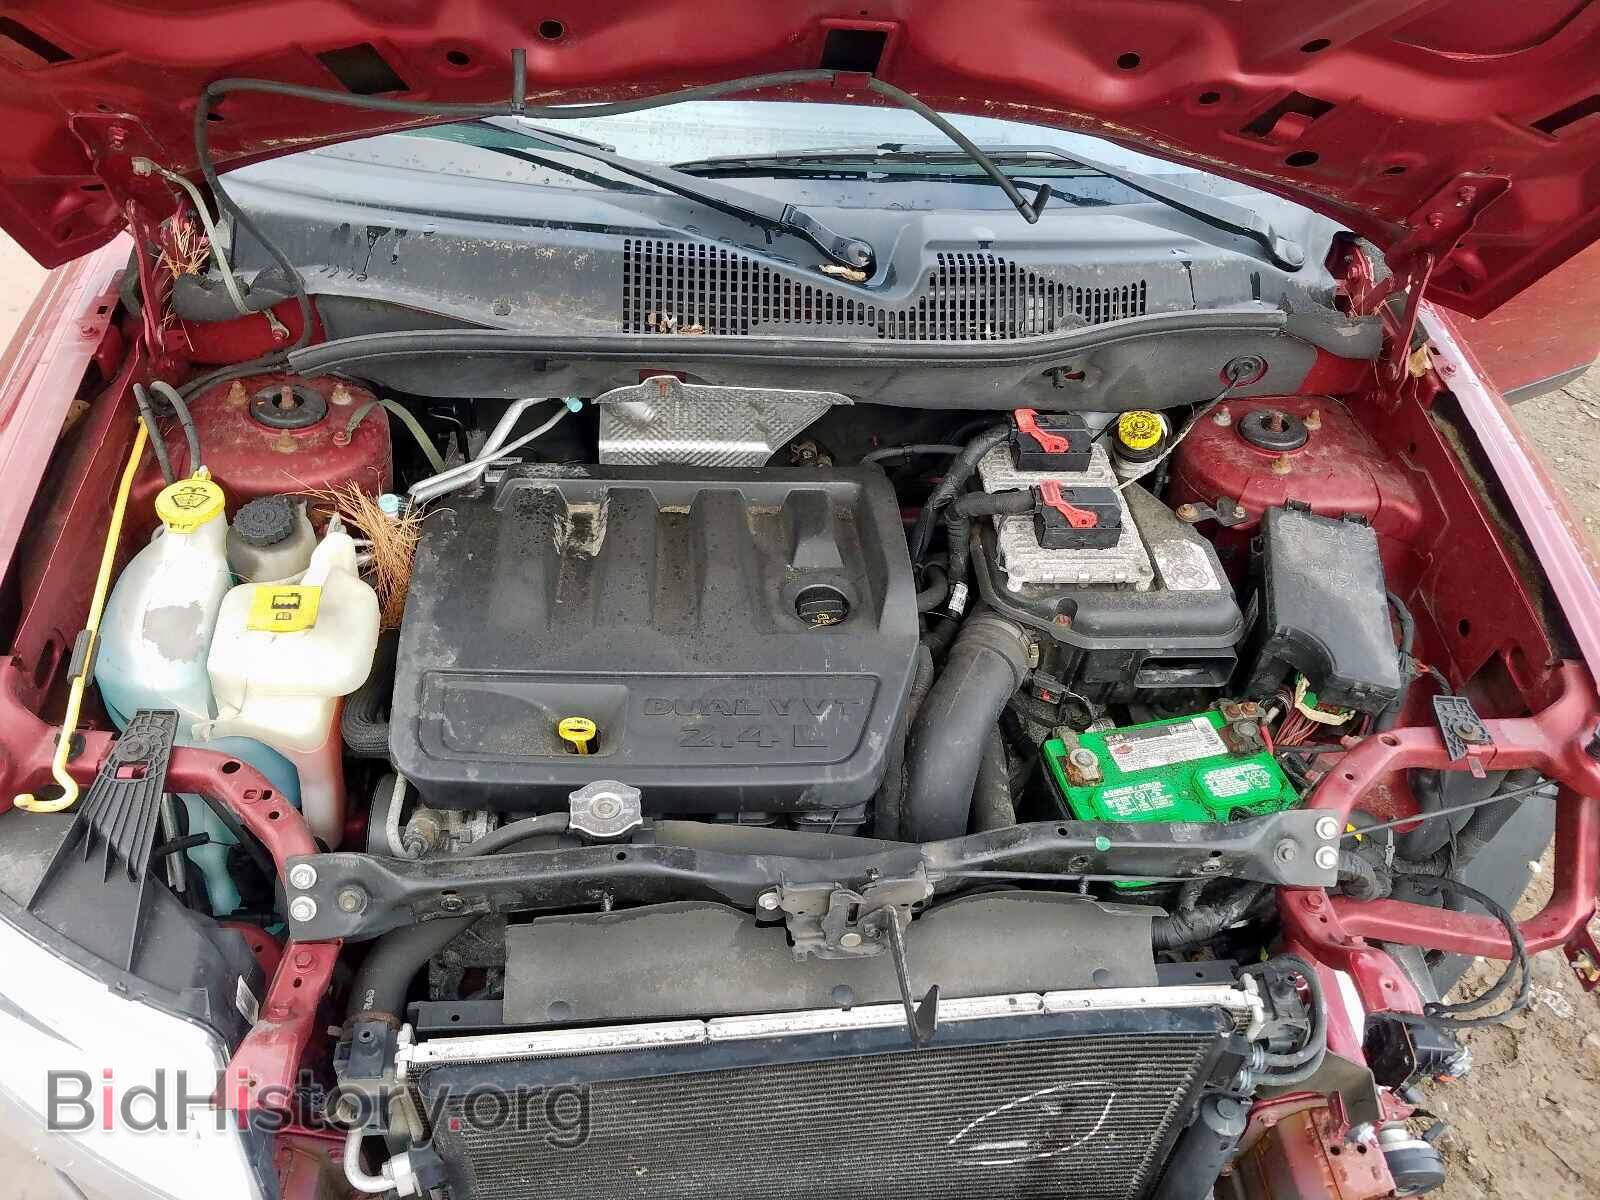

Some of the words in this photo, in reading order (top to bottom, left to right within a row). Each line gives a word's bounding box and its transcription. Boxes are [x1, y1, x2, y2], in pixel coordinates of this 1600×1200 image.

[643, 698, 762, 716] DUAL
[768, 698, 865, 717] VVT
[793, 724, 829, 748] L
